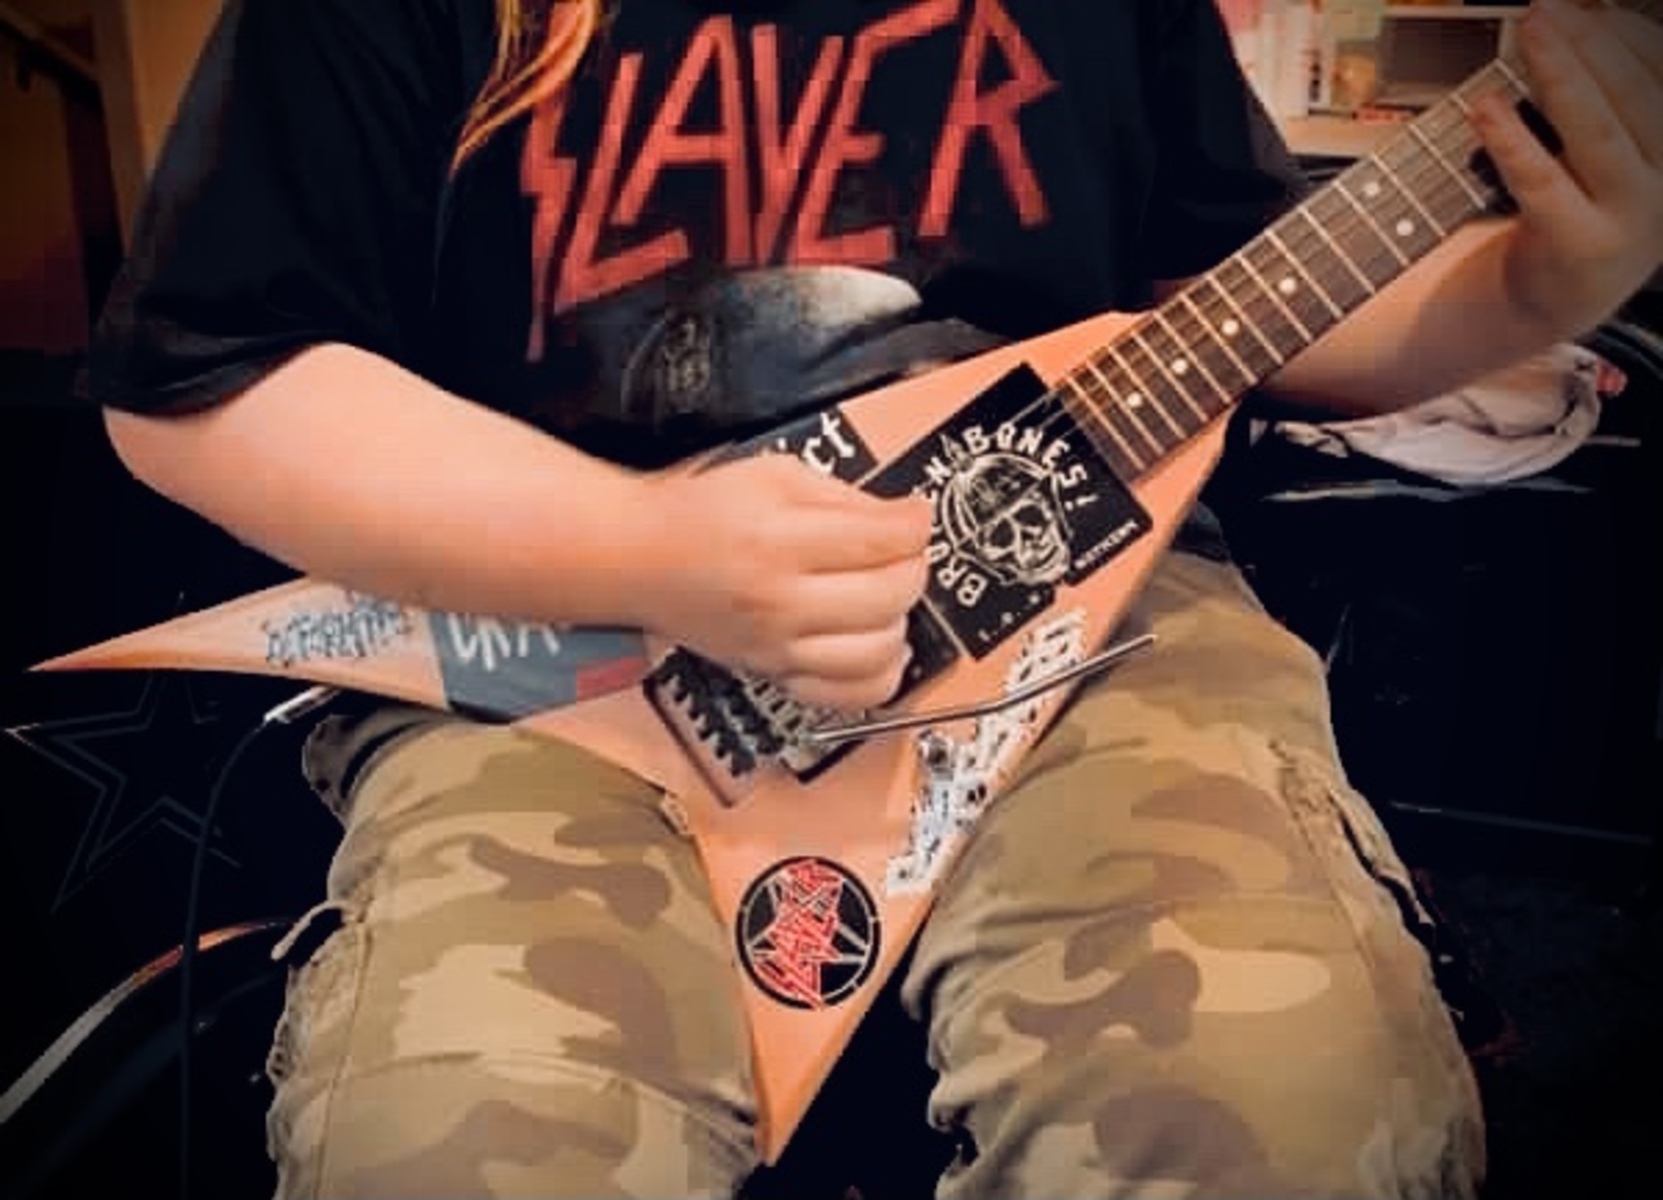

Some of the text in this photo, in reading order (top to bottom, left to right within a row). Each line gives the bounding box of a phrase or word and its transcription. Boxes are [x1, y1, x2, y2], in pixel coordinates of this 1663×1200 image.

[519, 0, 1060, 362] SLAYER
[922, 456, 988, 607] BRON
[961, 420, 1098, 511] BONES!
